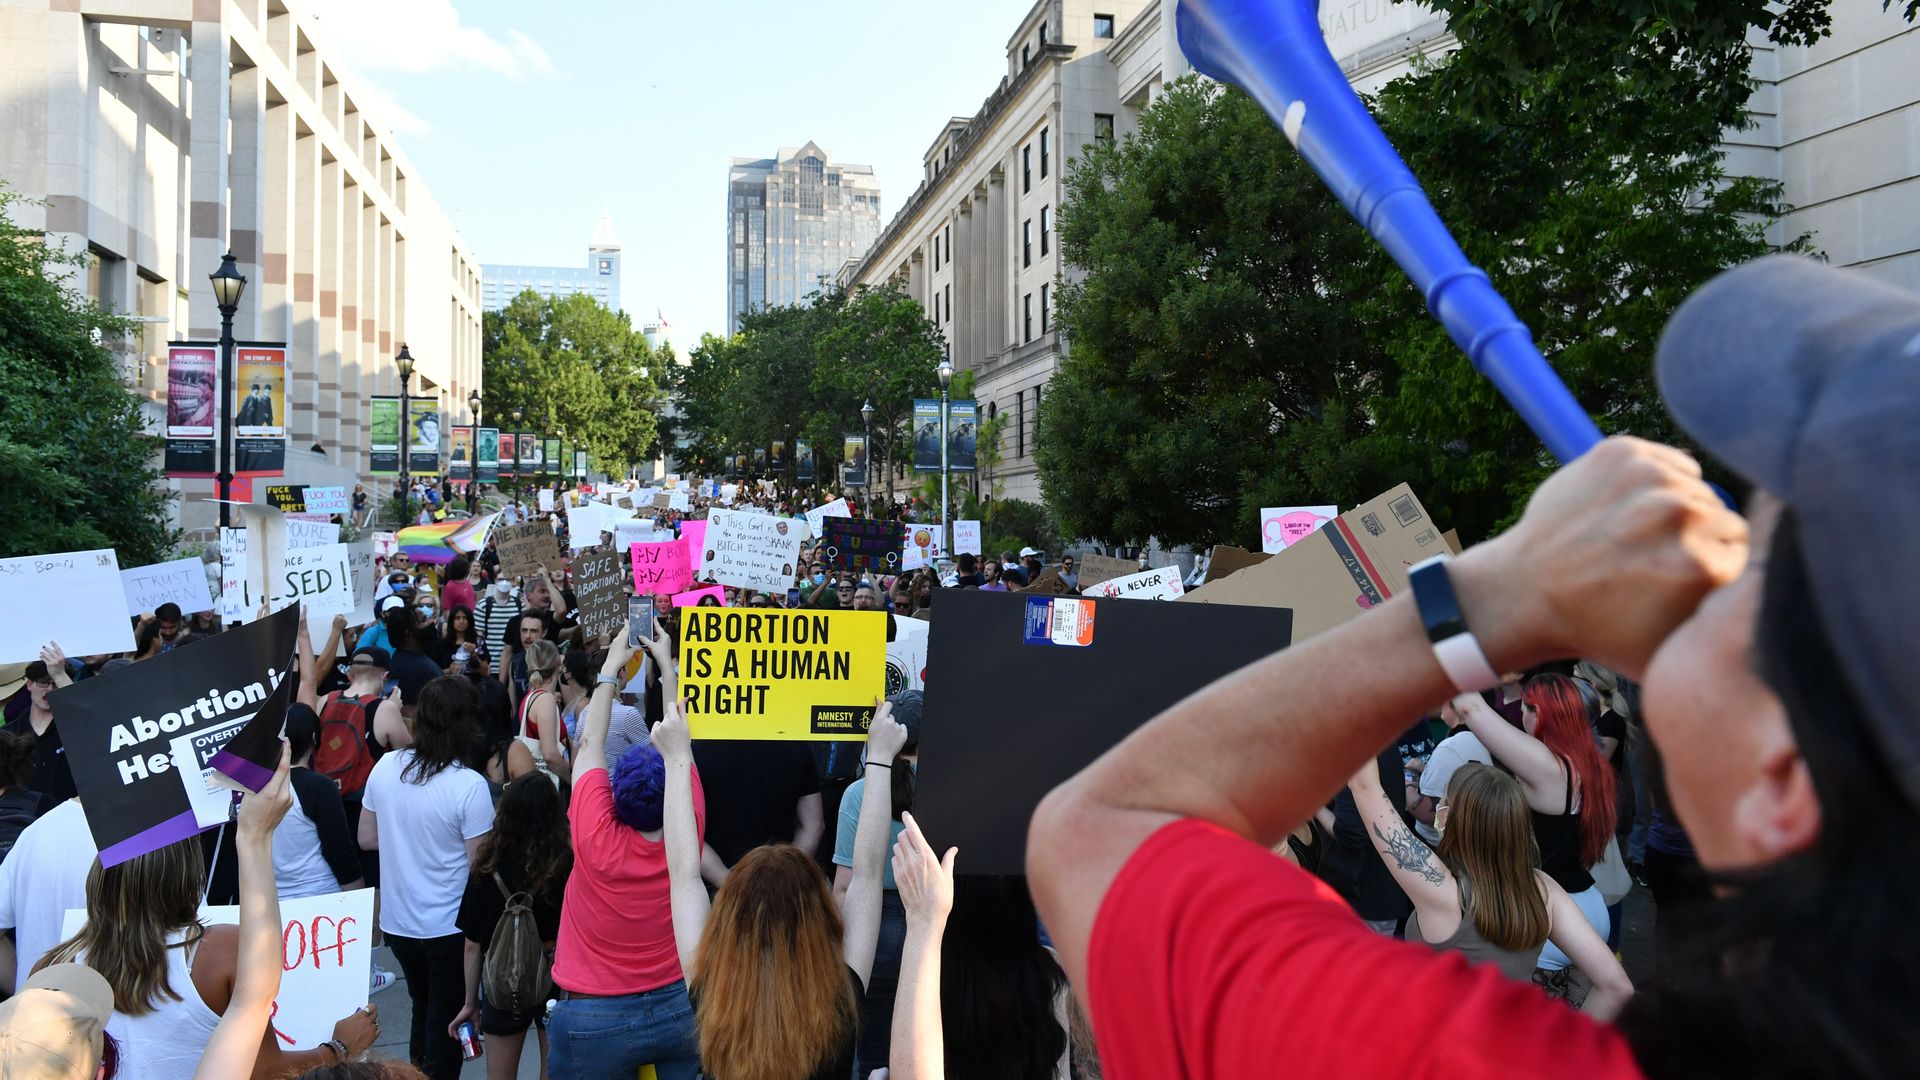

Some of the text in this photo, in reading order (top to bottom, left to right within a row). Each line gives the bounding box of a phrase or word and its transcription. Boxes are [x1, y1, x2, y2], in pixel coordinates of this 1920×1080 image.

[268, 486, 290, 494] FUCK
[304, 489, 346, 500] FUCK YOU
[305, 501, 347, 510] CLARENCE
[286, 521, 329, 540] YOU'RE
[724, 514, 744, 529] This
[748, 516, 763, 531] Girl
[956, 530, 975, 538] WAR
[717, 539, 743, 552] BITCH
[765, 536, 794, 551] SKANK
[635, 547, 661, 563] MY
[722, 554, 732, 565] Do
[736, 559, 748, 567] not
[769, 563, 779, 572] her
[580, 557, 612, 579] SAFE
[639, 568, 664, 584] MY
[716, 567, 728, 577] She
[765, 575, 783, 587] SLUT
[131, 570, 192, 590] TRUST
[577, 573, 620, 598] ABORTIONS
[1128, 574, 1162, 591] NEVER
[136, 586, 197, 608] WOMEN
[685, 612, 829, 644] ABORTION
[685, 648, 850, 680] IS A HUMAN
[683, 684, 770, 714] RIGHT
[110, 681, 267, 753] Abortion
[817, 711, 854, 721] AMNESTY
[196, 723, 246, 747] OVERT
[282, 916, 357, 971] OFF
